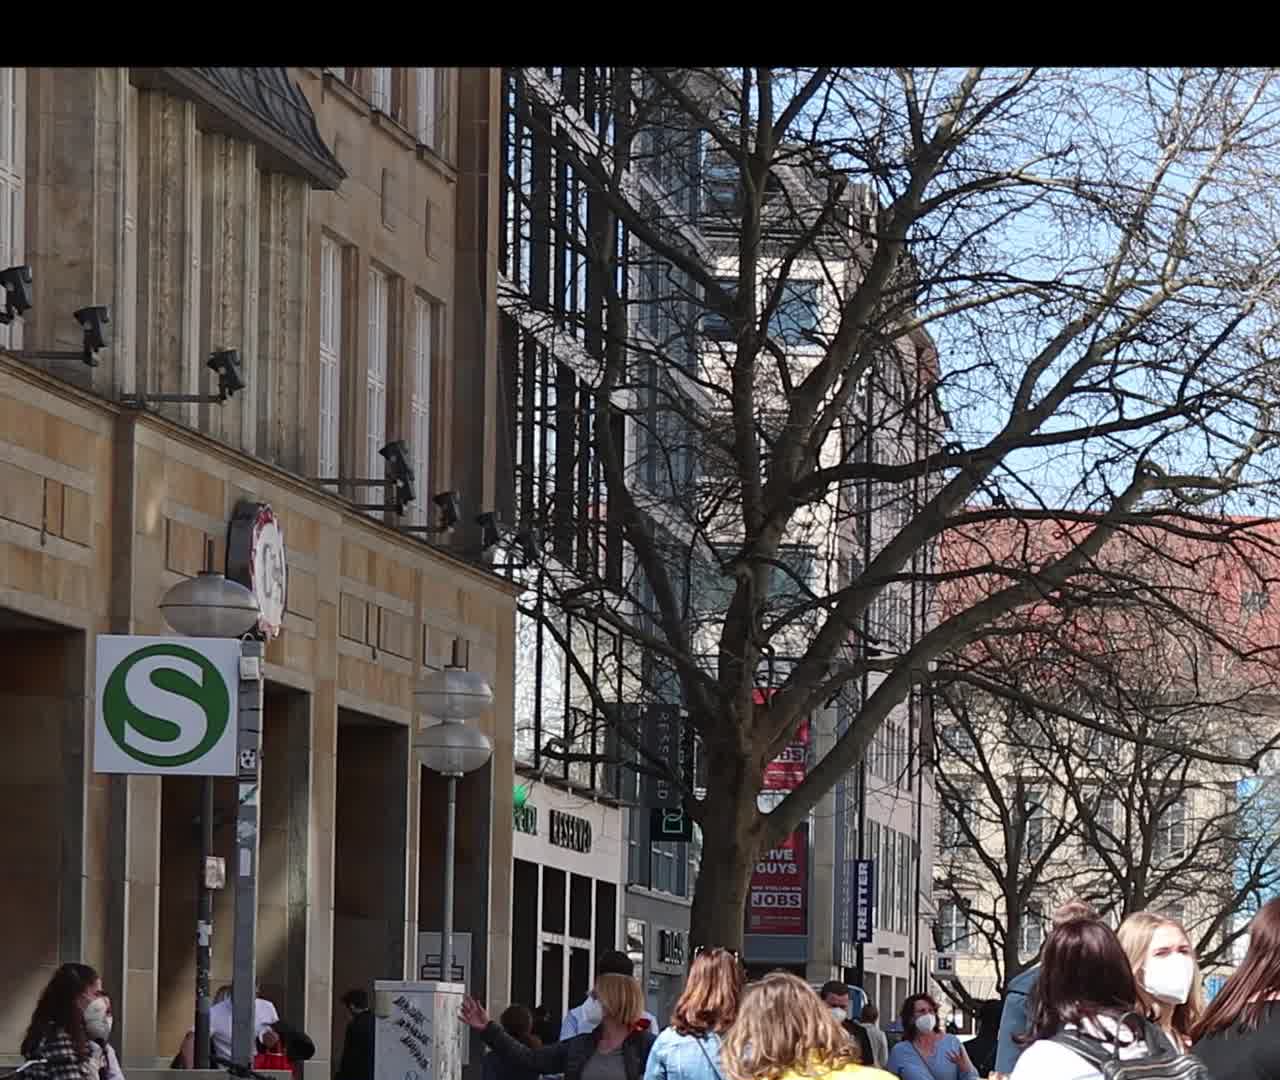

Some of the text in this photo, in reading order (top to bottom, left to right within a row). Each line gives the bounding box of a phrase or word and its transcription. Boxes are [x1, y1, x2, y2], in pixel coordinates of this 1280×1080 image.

[124, 654, 208, 757] S
[756, 862, 797, 874] GUYS
[753, 893, 800, 906] JOBS
[857, 862, 869, 941] TRETTER
